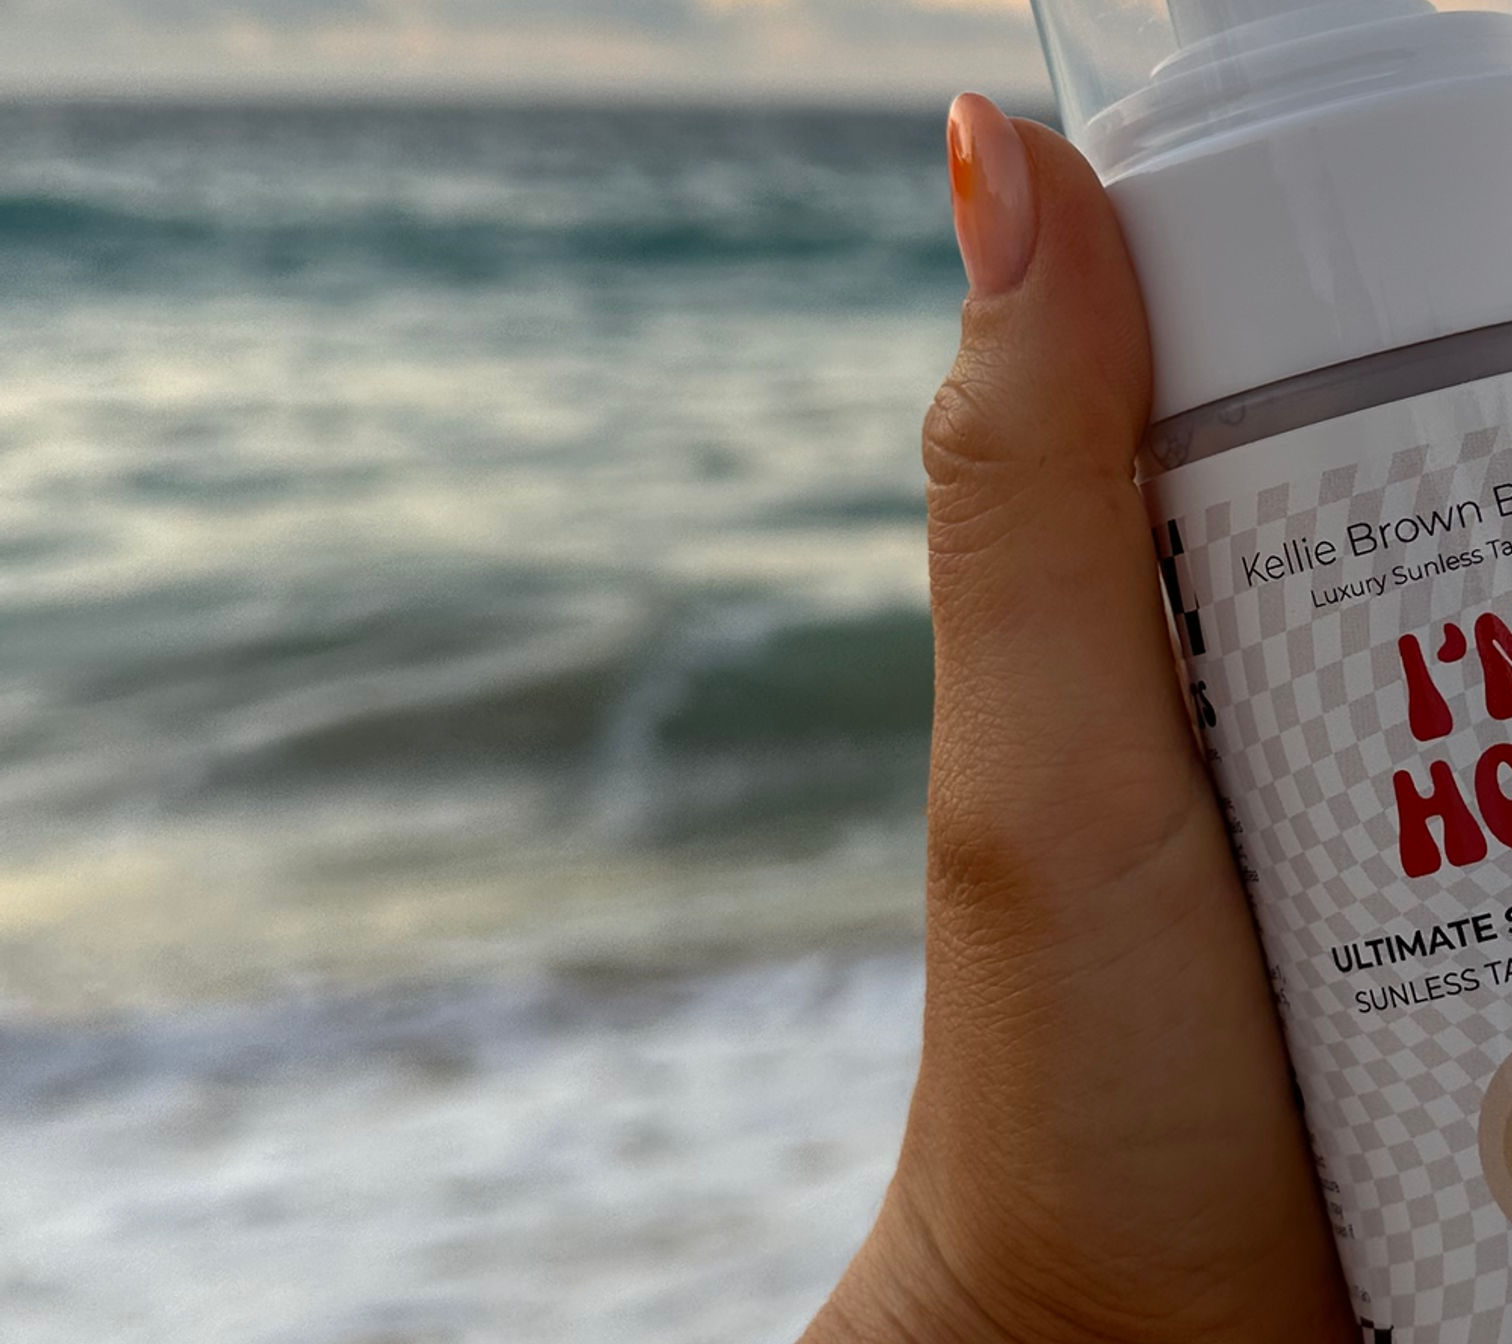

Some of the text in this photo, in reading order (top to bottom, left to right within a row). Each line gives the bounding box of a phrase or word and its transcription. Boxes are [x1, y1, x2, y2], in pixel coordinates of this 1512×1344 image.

[1242, 537, 1336, 587] Kellie
[1347, 500, 1483, 557] Brown
[1311, 572, 1387, 608] Luxury
[1394, 547, 1484, 586] Sunless
[1332, 913, 1498, 973] ULTIMATE
[1355, 968, 1480, 1013] SUNLESS
